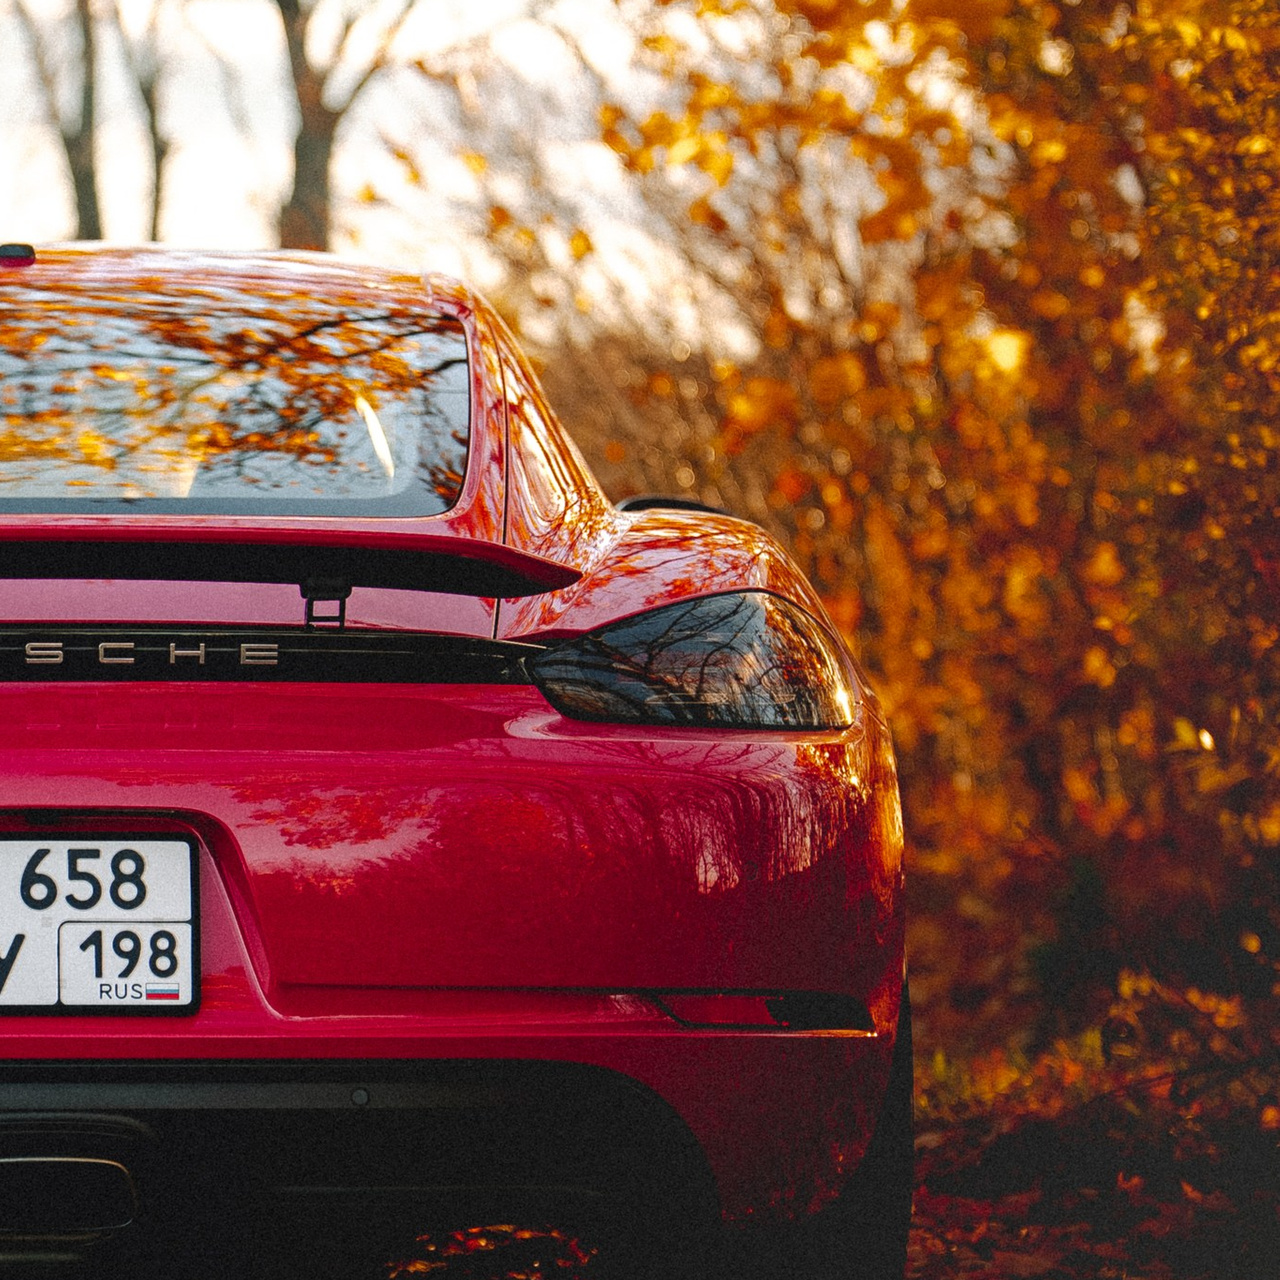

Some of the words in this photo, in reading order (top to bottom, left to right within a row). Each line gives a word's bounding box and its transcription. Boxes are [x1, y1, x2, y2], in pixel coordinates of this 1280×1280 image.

[20, 849, 147, 910] 658
[79, 930, 178, 978] 198
[99, 983, 143, 1000] RUS
